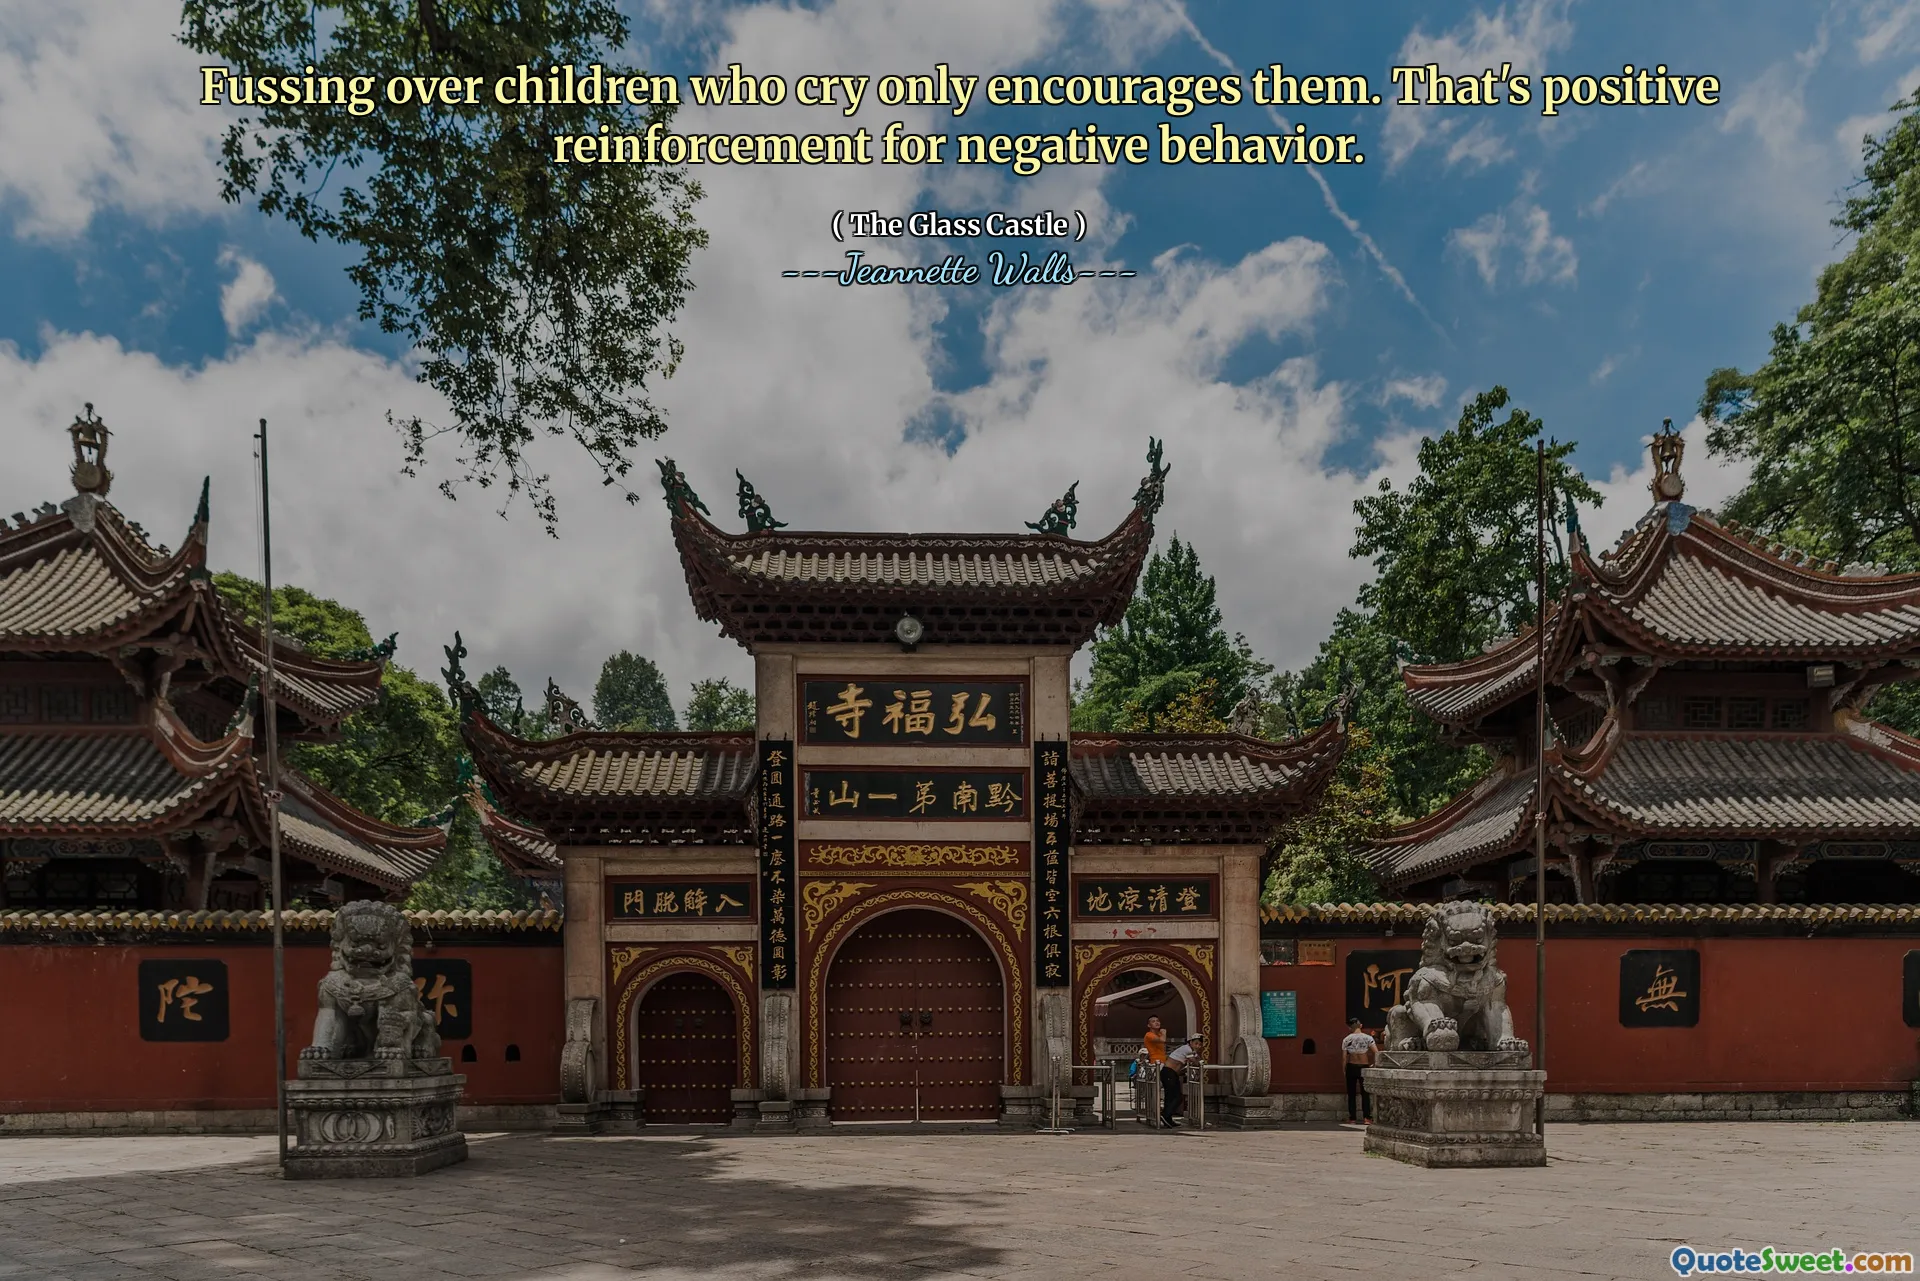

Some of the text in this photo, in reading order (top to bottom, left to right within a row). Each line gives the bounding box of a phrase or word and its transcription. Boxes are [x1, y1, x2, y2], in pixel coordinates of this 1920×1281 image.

[826, 683, 997, 739] 弘福寺
[829, 779, 1023, 814] 黔南第一山
[1362, 963, 1414, 1013] 阿
